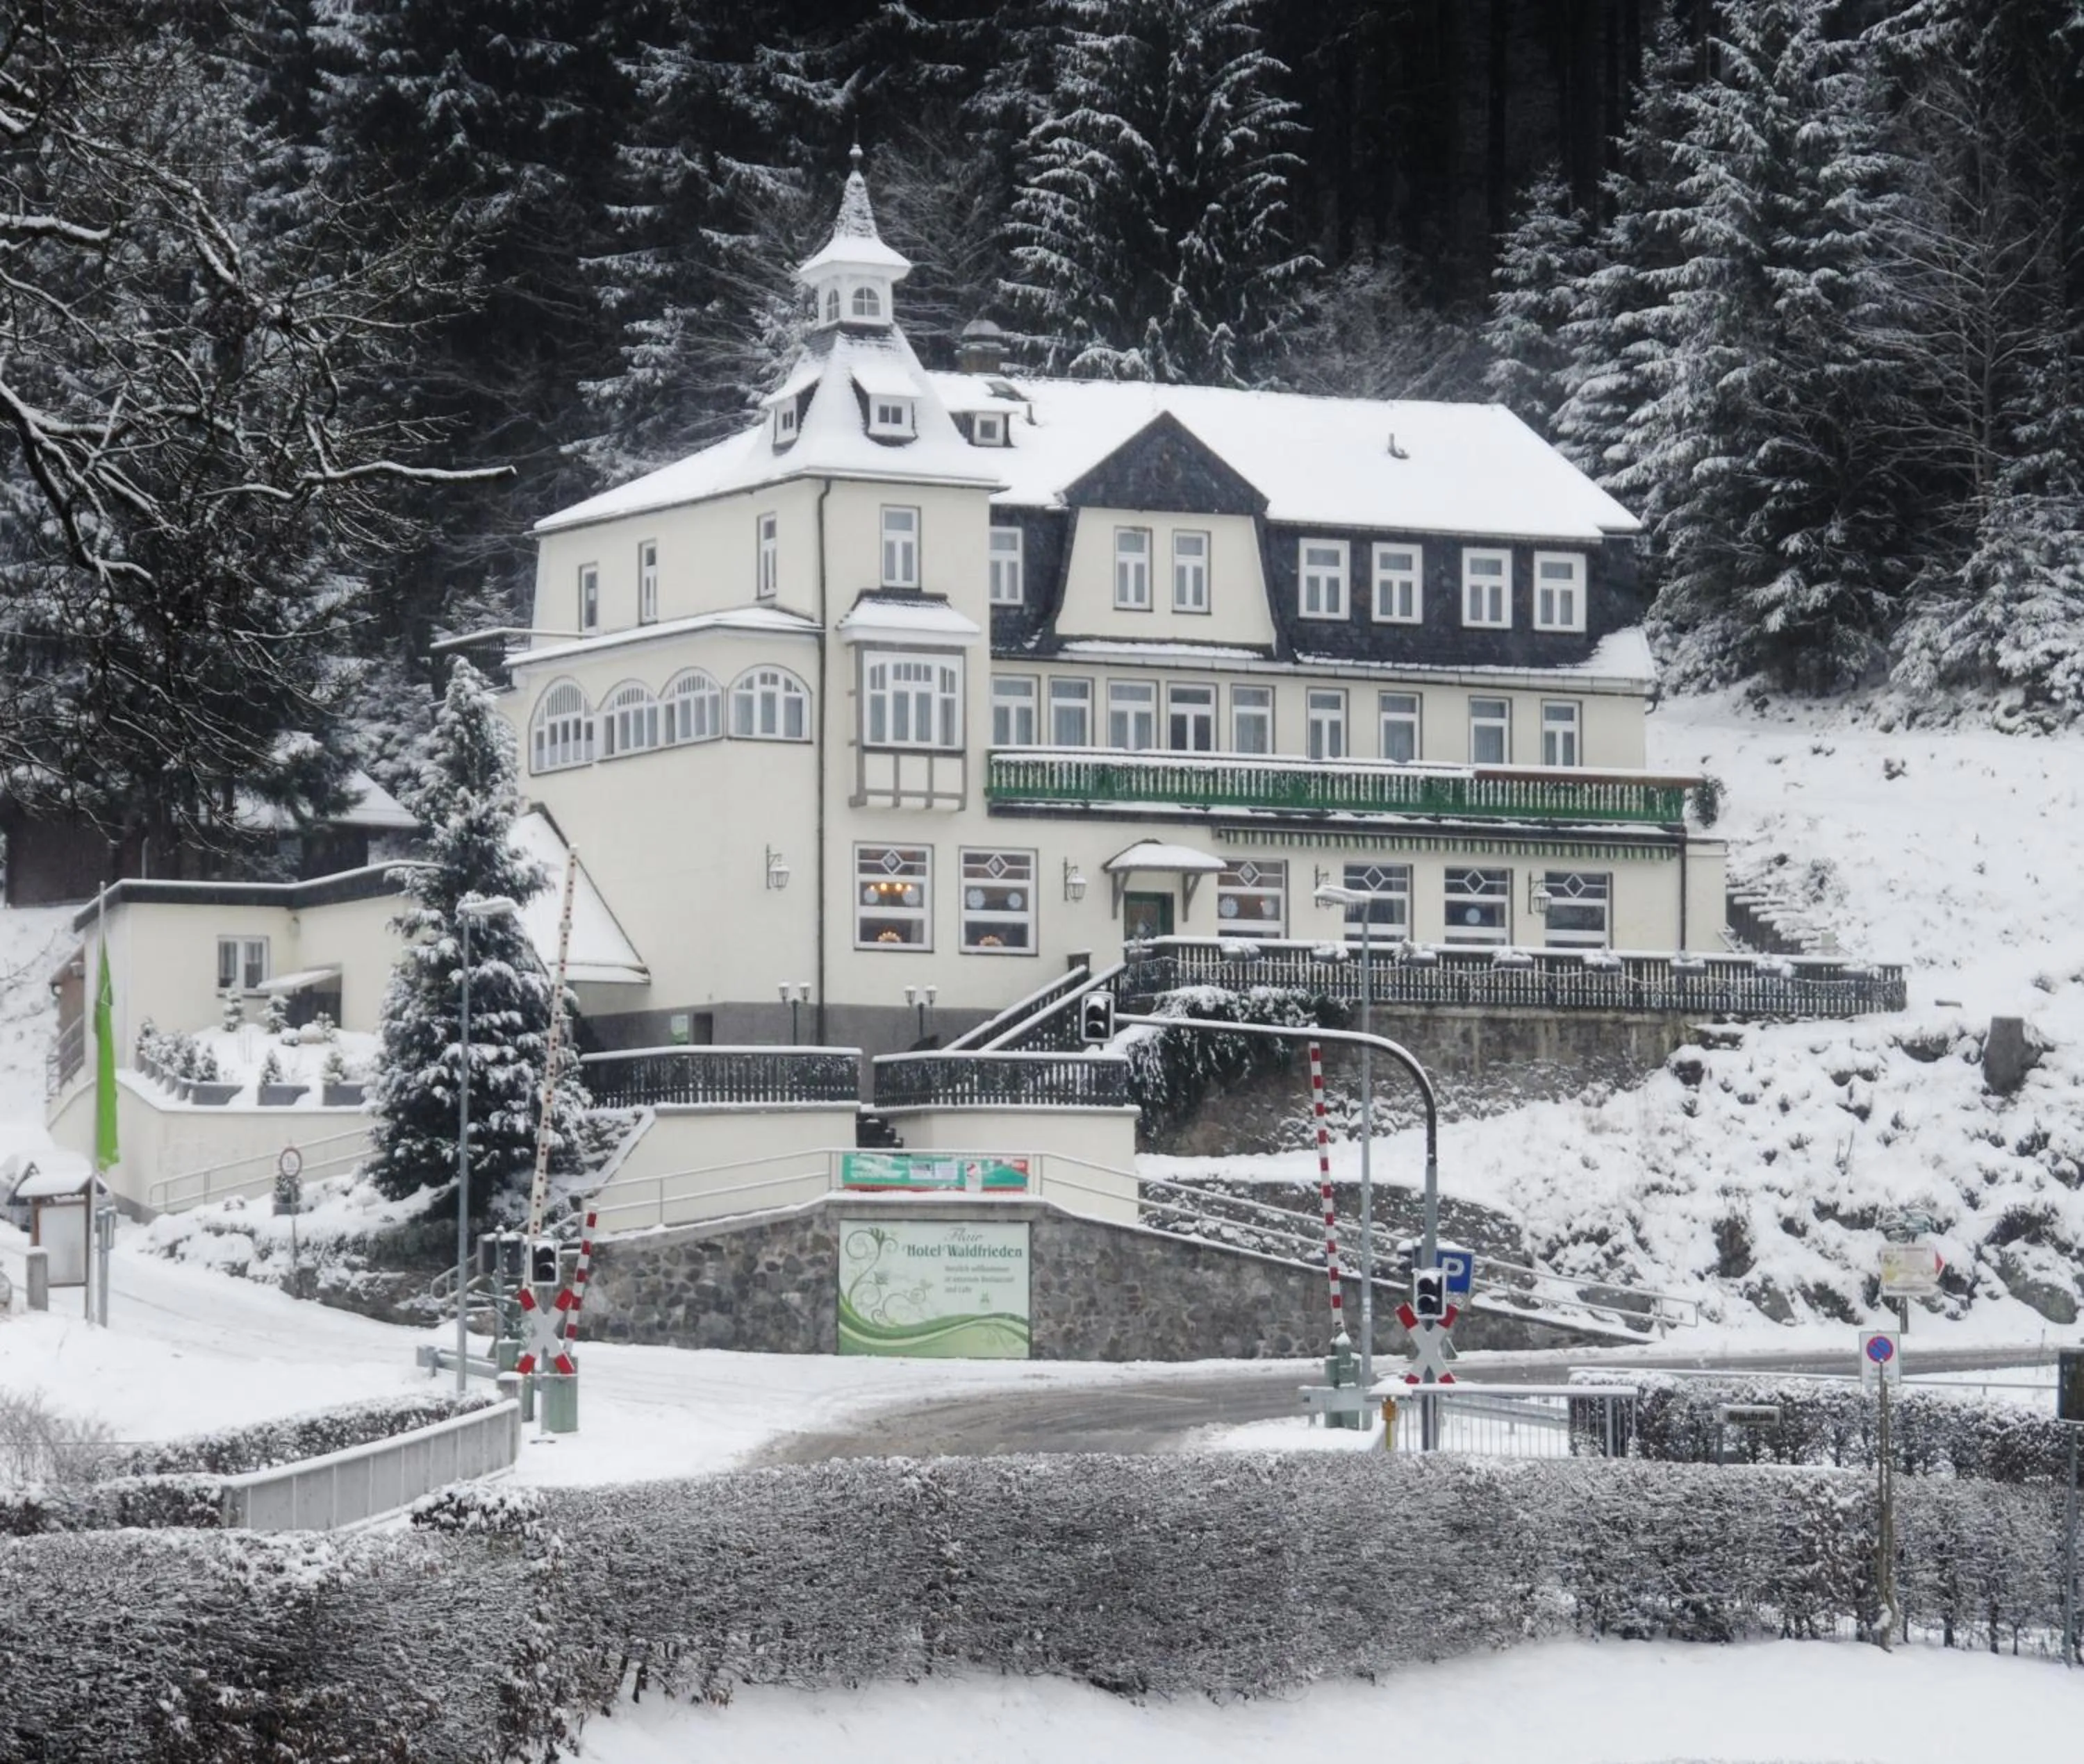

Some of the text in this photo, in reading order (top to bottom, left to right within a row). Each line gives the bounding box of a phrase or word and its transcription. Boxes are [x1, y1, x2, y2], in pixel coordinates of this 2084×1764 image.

[906, 1244, 1023, 1257] Hotel Waldfrieden
[1442, 1257, 1464, 1277] P
